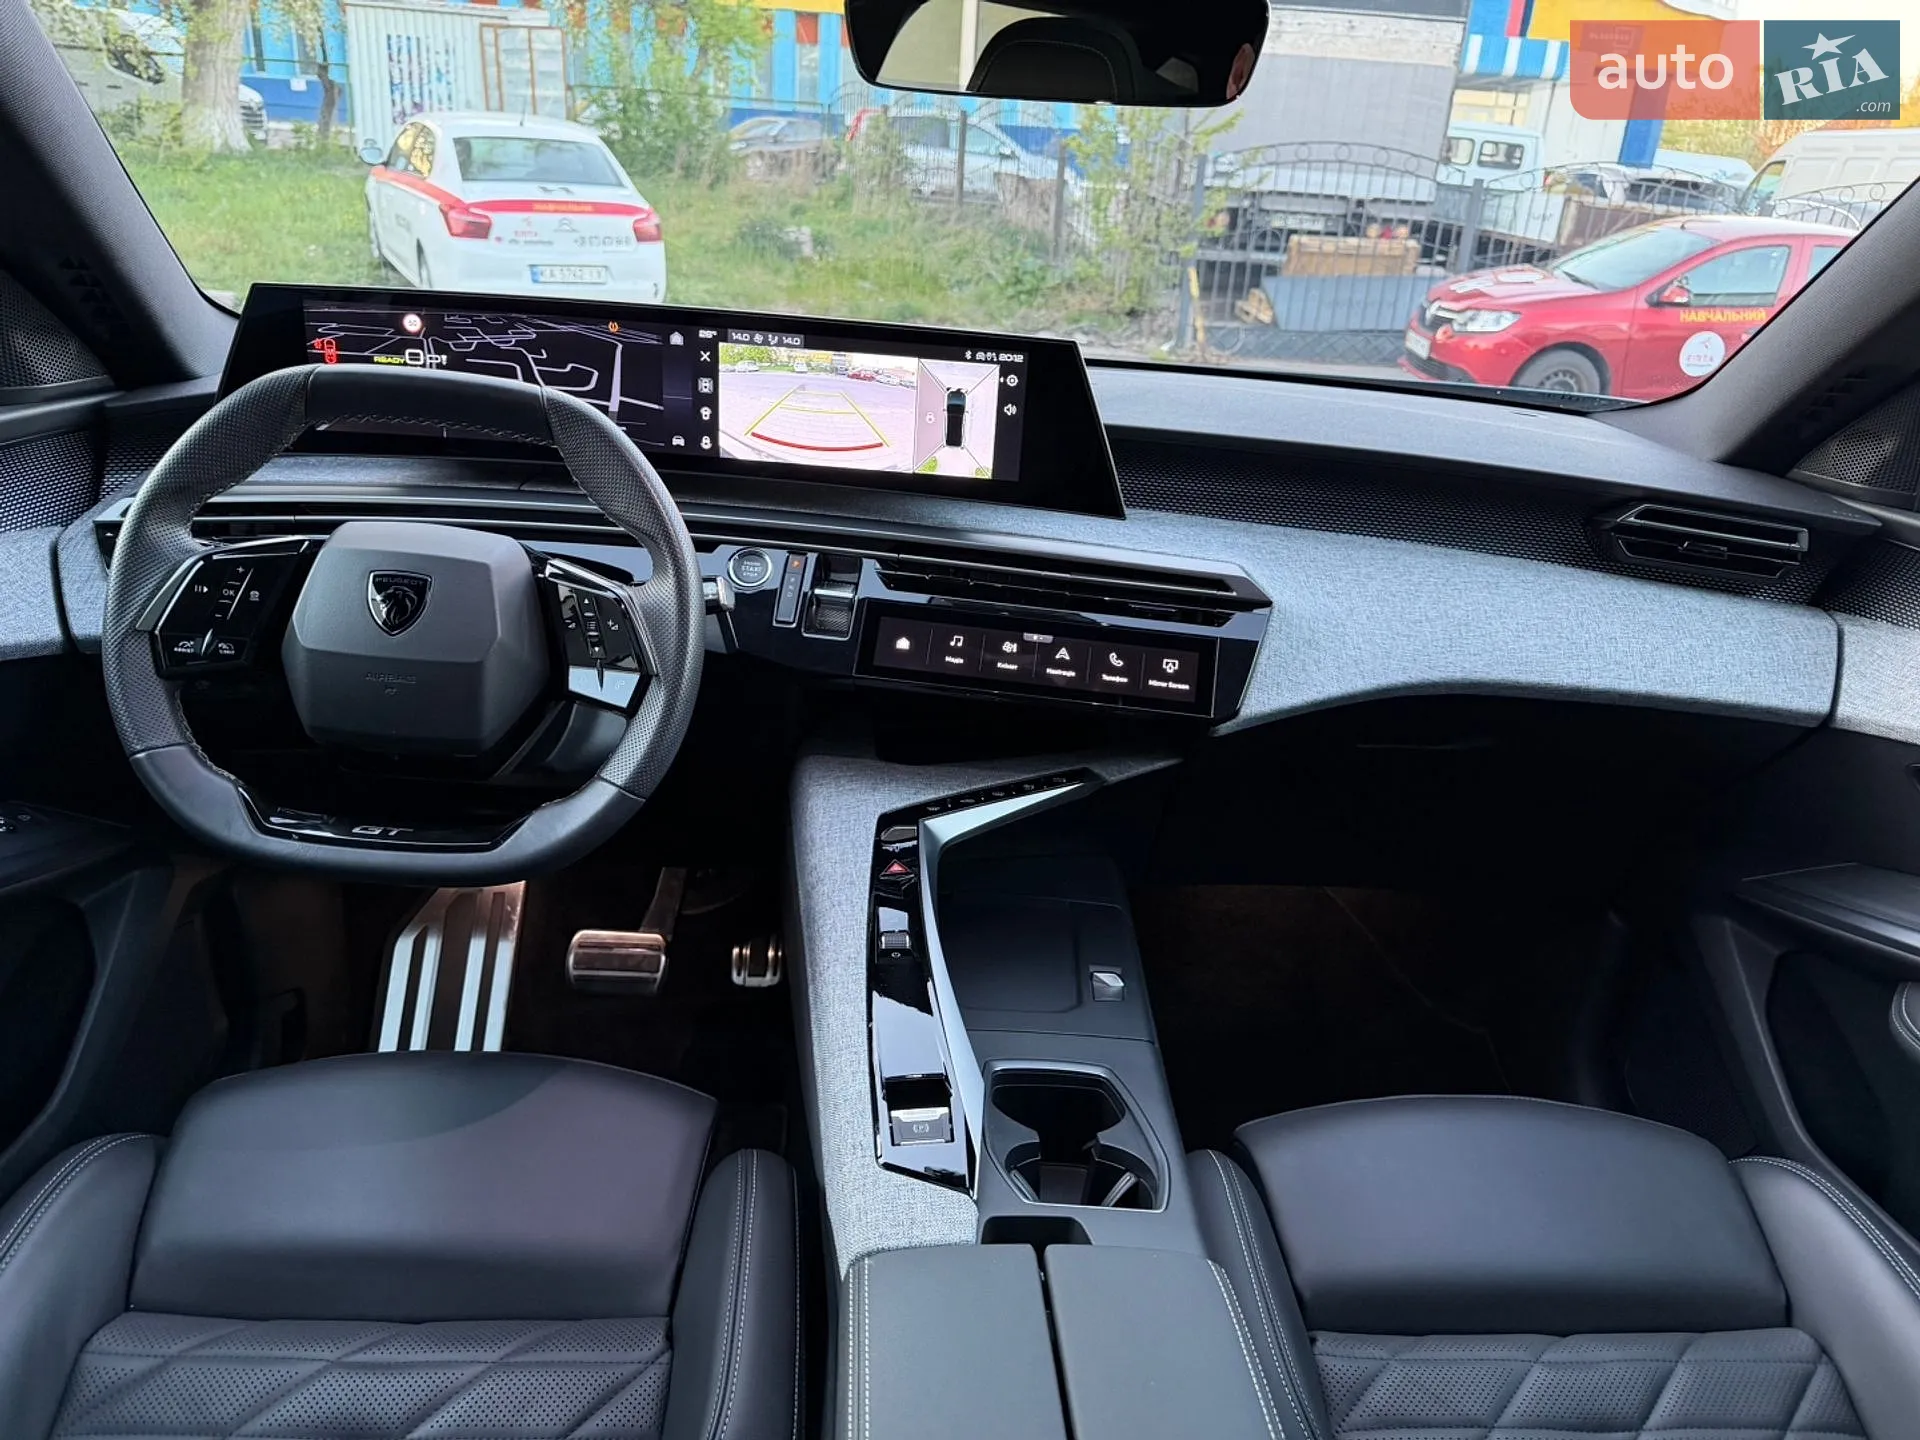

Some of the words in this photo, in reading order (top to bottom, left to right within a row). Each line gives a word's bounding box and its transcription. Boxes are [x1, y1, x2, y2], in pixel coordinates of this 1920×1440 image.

[1680, 308, 1766, 322] НАВЧАЛЬНИЙ
[373, 356, 404, 364] READY
[375, 577, 424, 585] PEUGEOT
[222, 588, 235, 597] OK
[352, 825, 414, 836] GT
